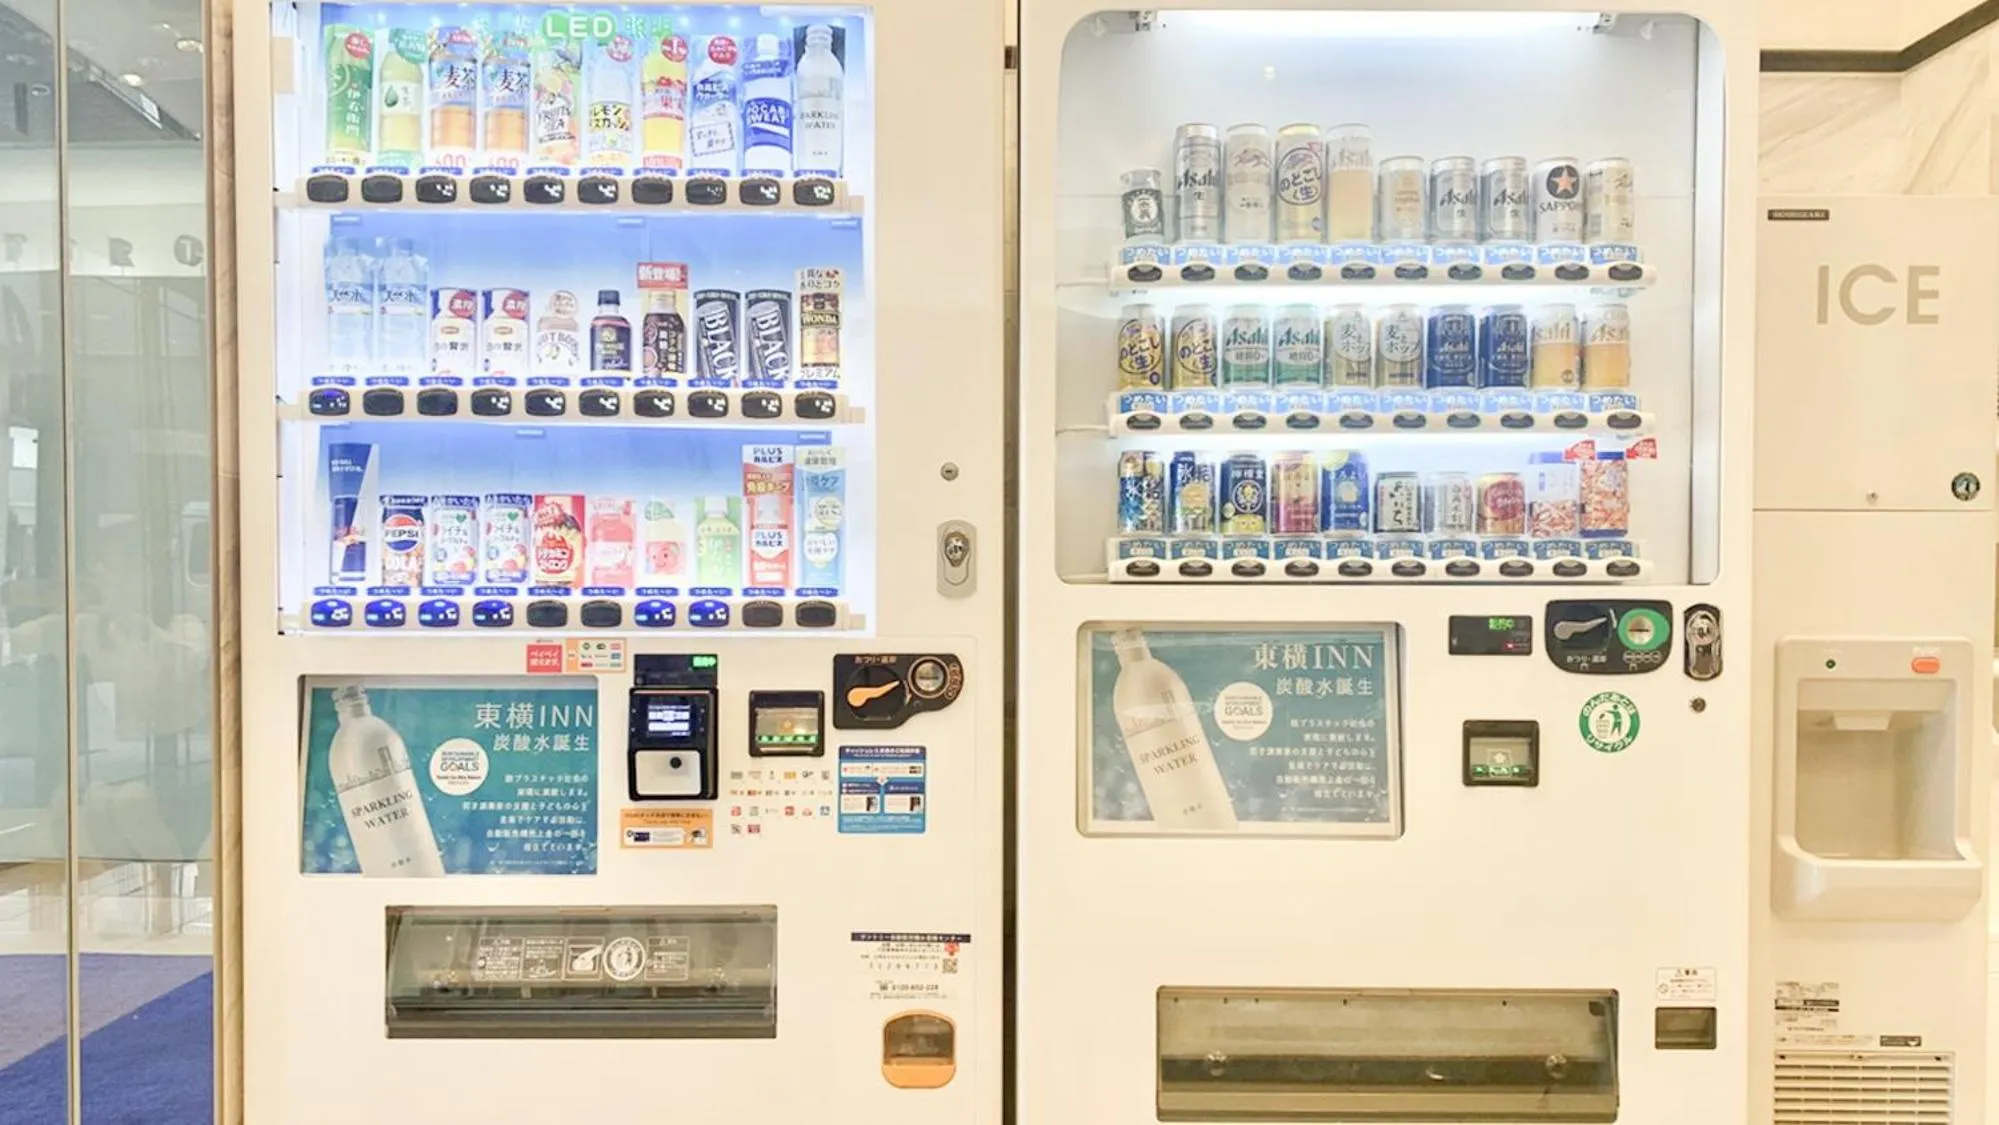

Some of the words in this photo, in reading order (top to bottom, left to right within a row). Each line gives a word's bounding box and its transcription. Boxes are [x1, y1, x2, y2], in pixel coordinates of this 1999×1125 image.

[545, 15, 613, 39] LED
[447, 63, 477, 90] 麦茶
[501, 67, 530, 95] 麦茶
[1816, 263, 1940, 326] ICE
[704, 308, 738, 378] BLACK
[755, 308, 790, 378] BLACK
[1225, 326, 1269, 347] Asahi
[1278, 326, 1320, 347] Asahi
[753, 447, 783, 456] PLUS
[385, 529, 419, 539] PEPSI
[755, 531, 783, 540] PLUS
[1253, 642, 1375, 671] 東横INN
[1275, 677, 1374, 698] 炭酸水誕生
[473, 702, 594, 730] 東横INN
[1224, 705, 1264, 717] GOALS
[492, 734, 590, 753] 炭酸水誕生
[1139, 734, 1201, 765] SPARKLING
[440, 761, 479, 772] GOALS
[1151, 753, 1199, 777] WATER
[350, 790, 413, 819] SPARKLING
[364, 807, 410, 831] WATER
